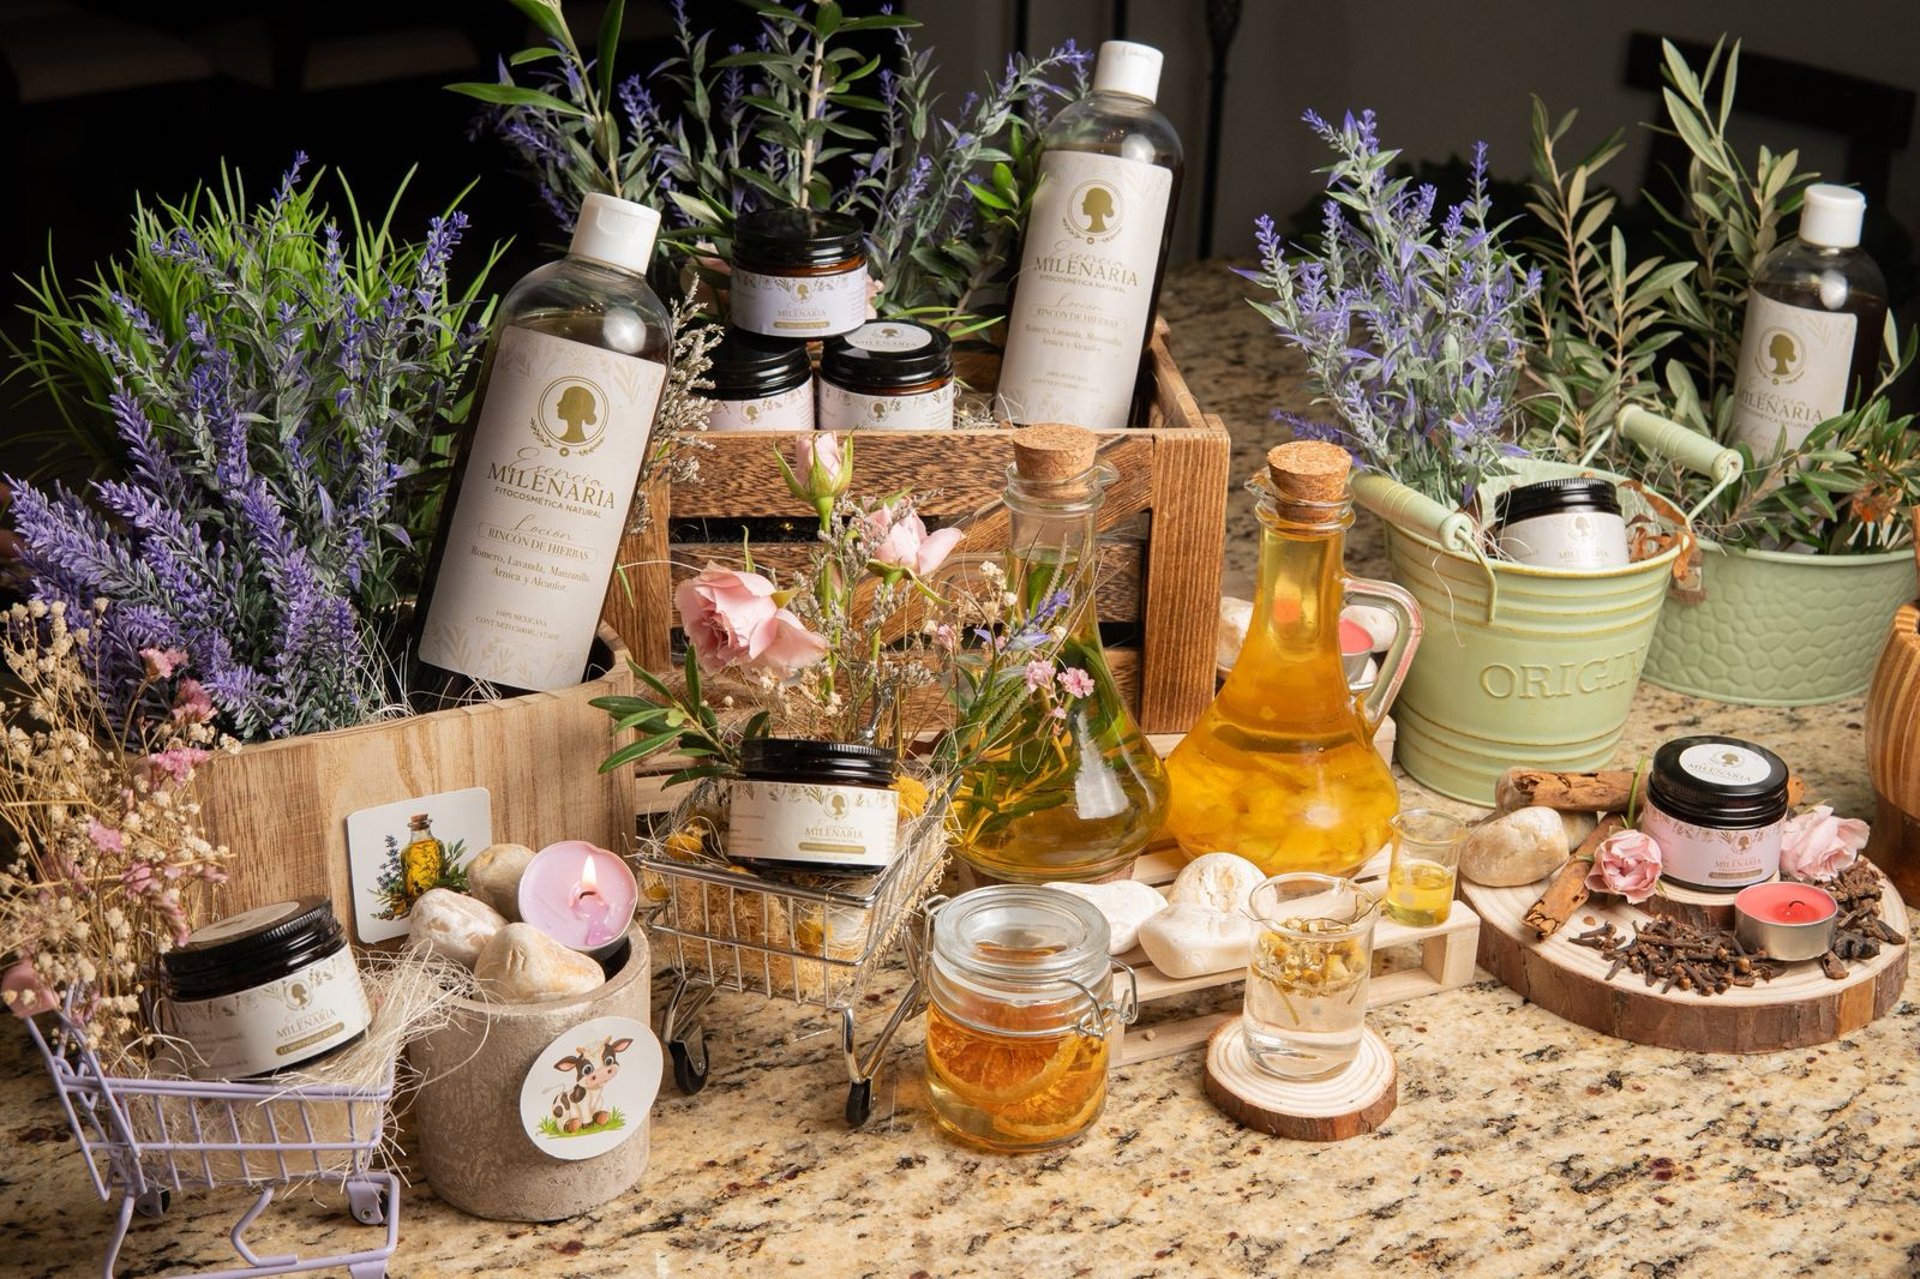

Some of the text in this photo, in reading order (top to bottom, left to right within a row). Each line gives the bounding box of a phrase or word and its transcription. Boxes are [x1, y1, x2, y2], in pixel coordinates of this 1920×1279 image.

[1033, 256, 1138, 286] MILENARIA
[487, 462, 615, 509] MILENARIA
[565, 505, 602, 519] NATURAL
[530, 539, 547, 552] DE
[547, 542, 590, 560] HIERBAS
